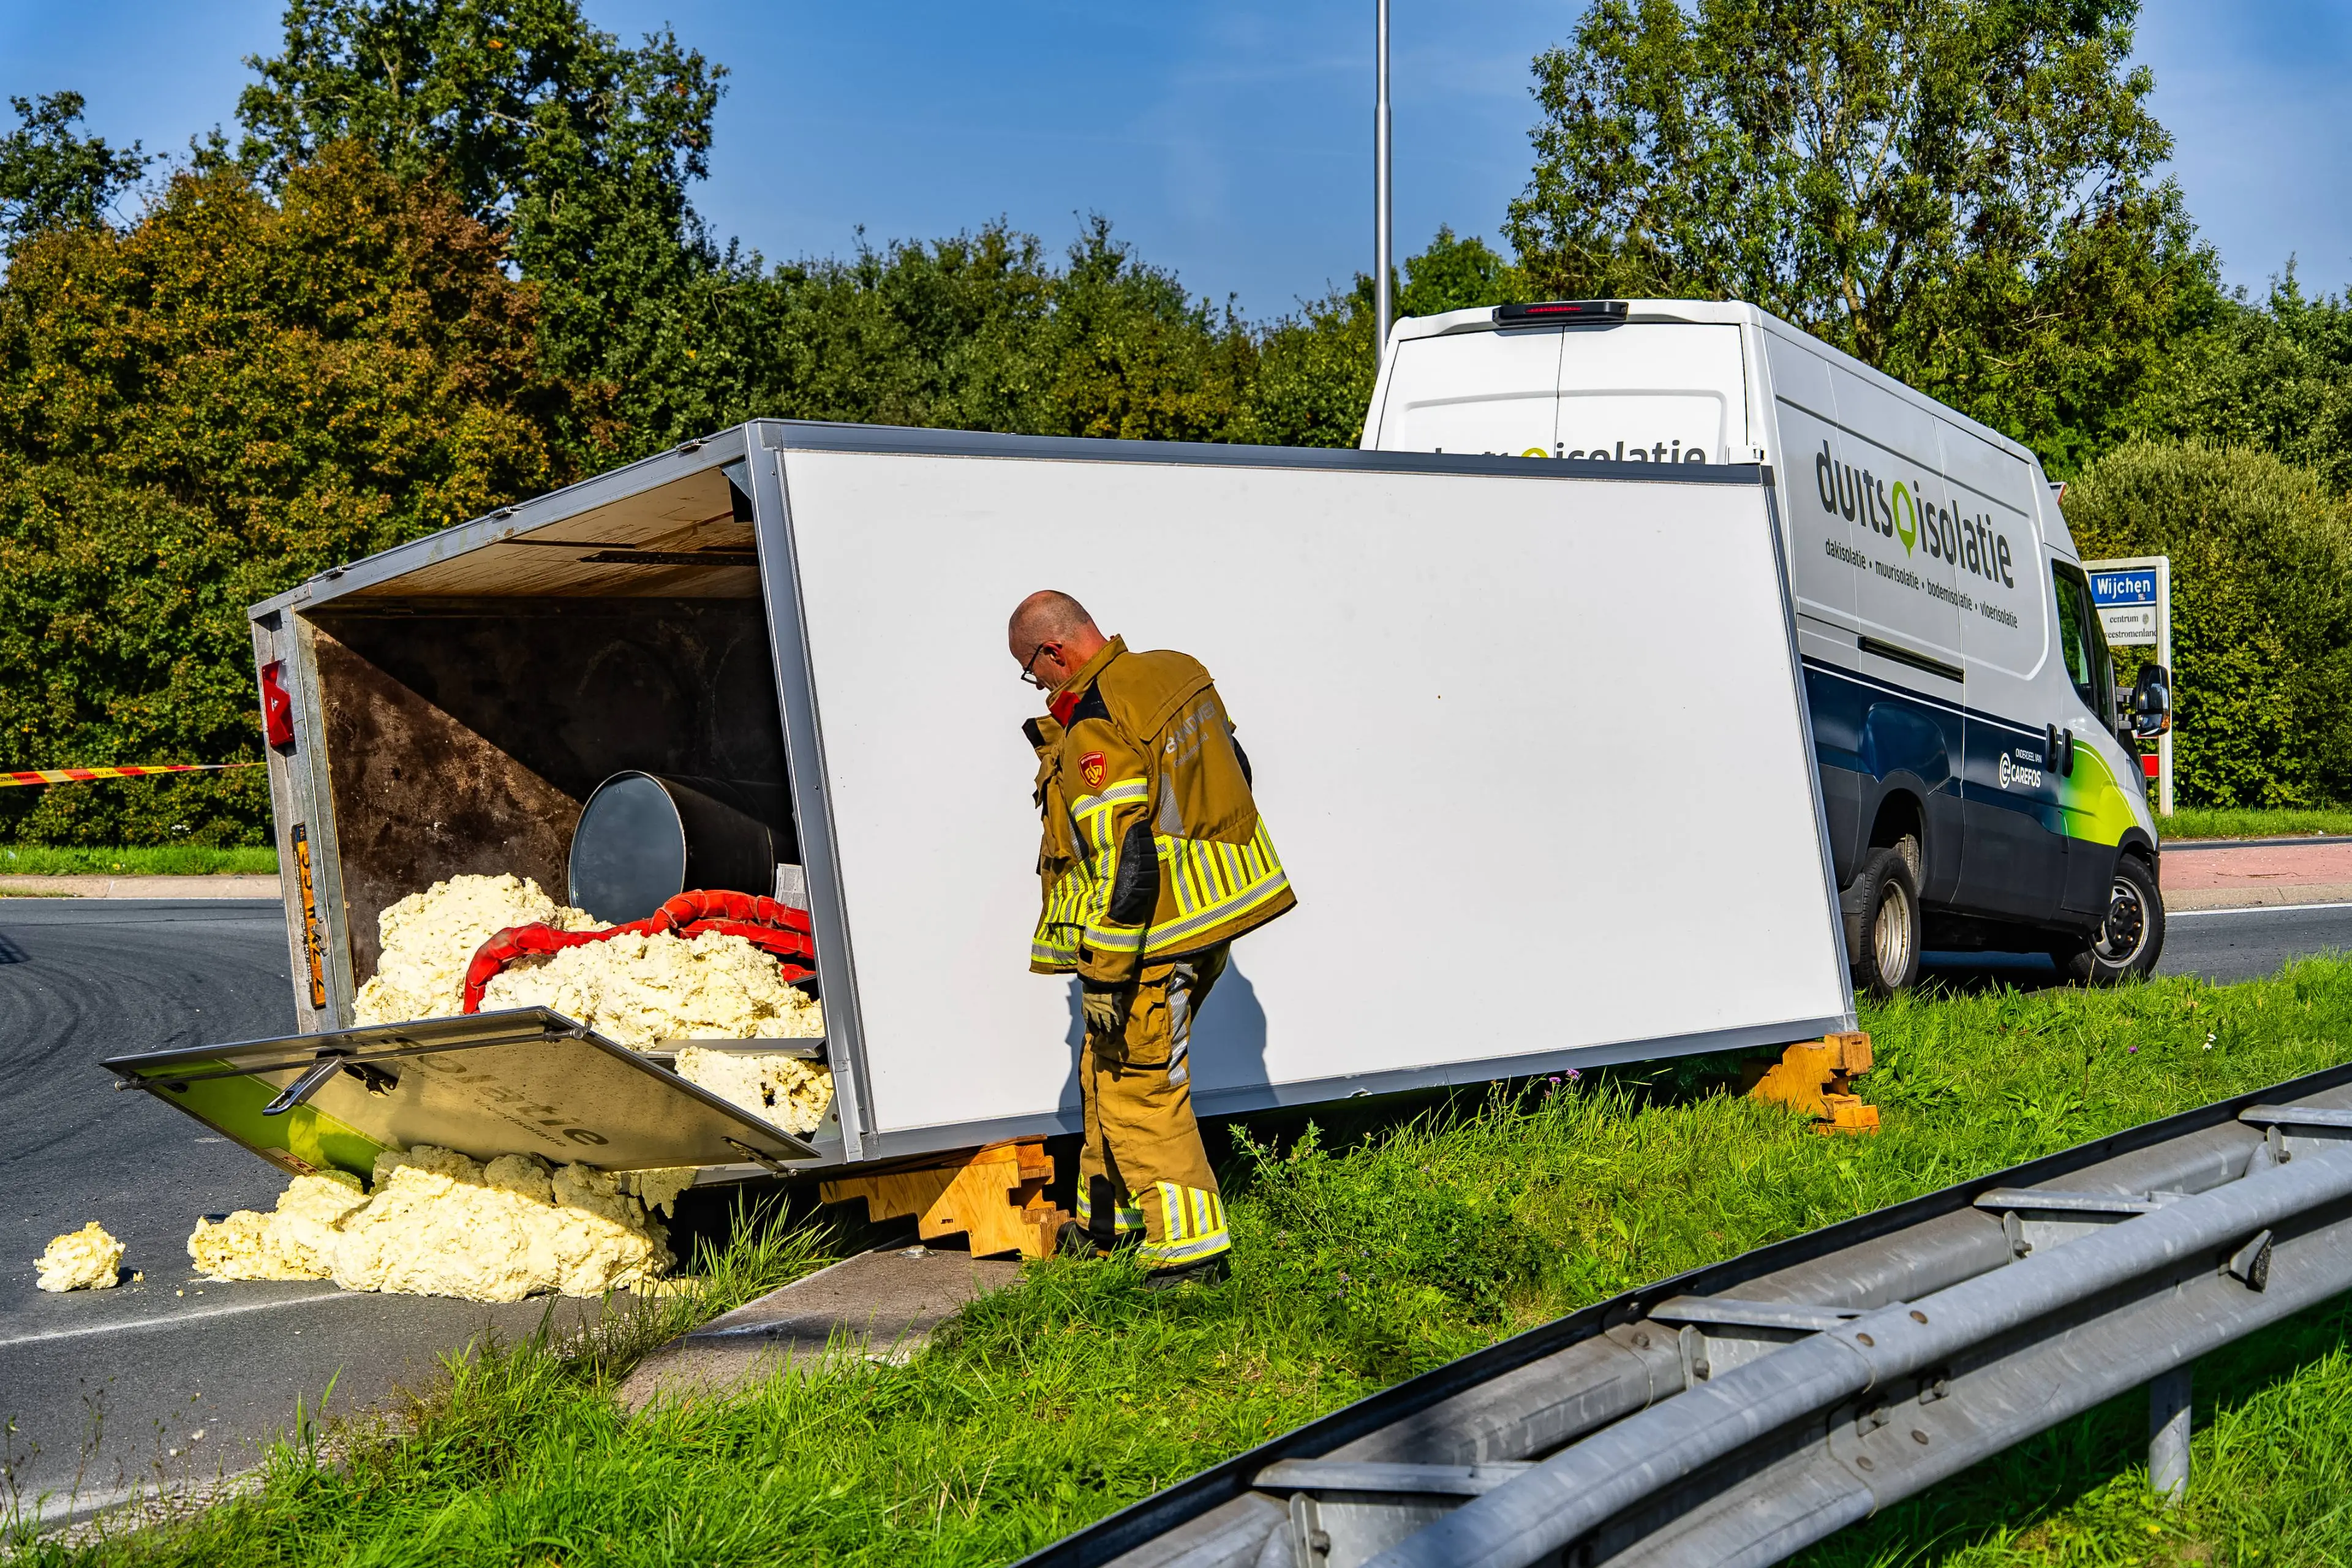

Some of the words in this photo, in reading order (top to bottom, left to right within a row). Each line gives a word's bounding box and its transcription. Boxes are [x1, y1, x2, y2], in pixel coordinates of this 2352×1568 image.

[1913, 480, 2015, 589] isolatie
[1825, 538, 1866, 570] dakisolatie
[1875, 559, 1920, 590] muurisolatie
[1927, 578, 1973, 611] bodemisolatie
[1980, 601, 2018, 629] vloerisolatie
[2097, 577, 2151, 600] Wijchen
[2109, 615, 2139, 624] centrum
[2010, 764, 2041, 788] CAREFOS
[299, 827, 305, 840] NL
